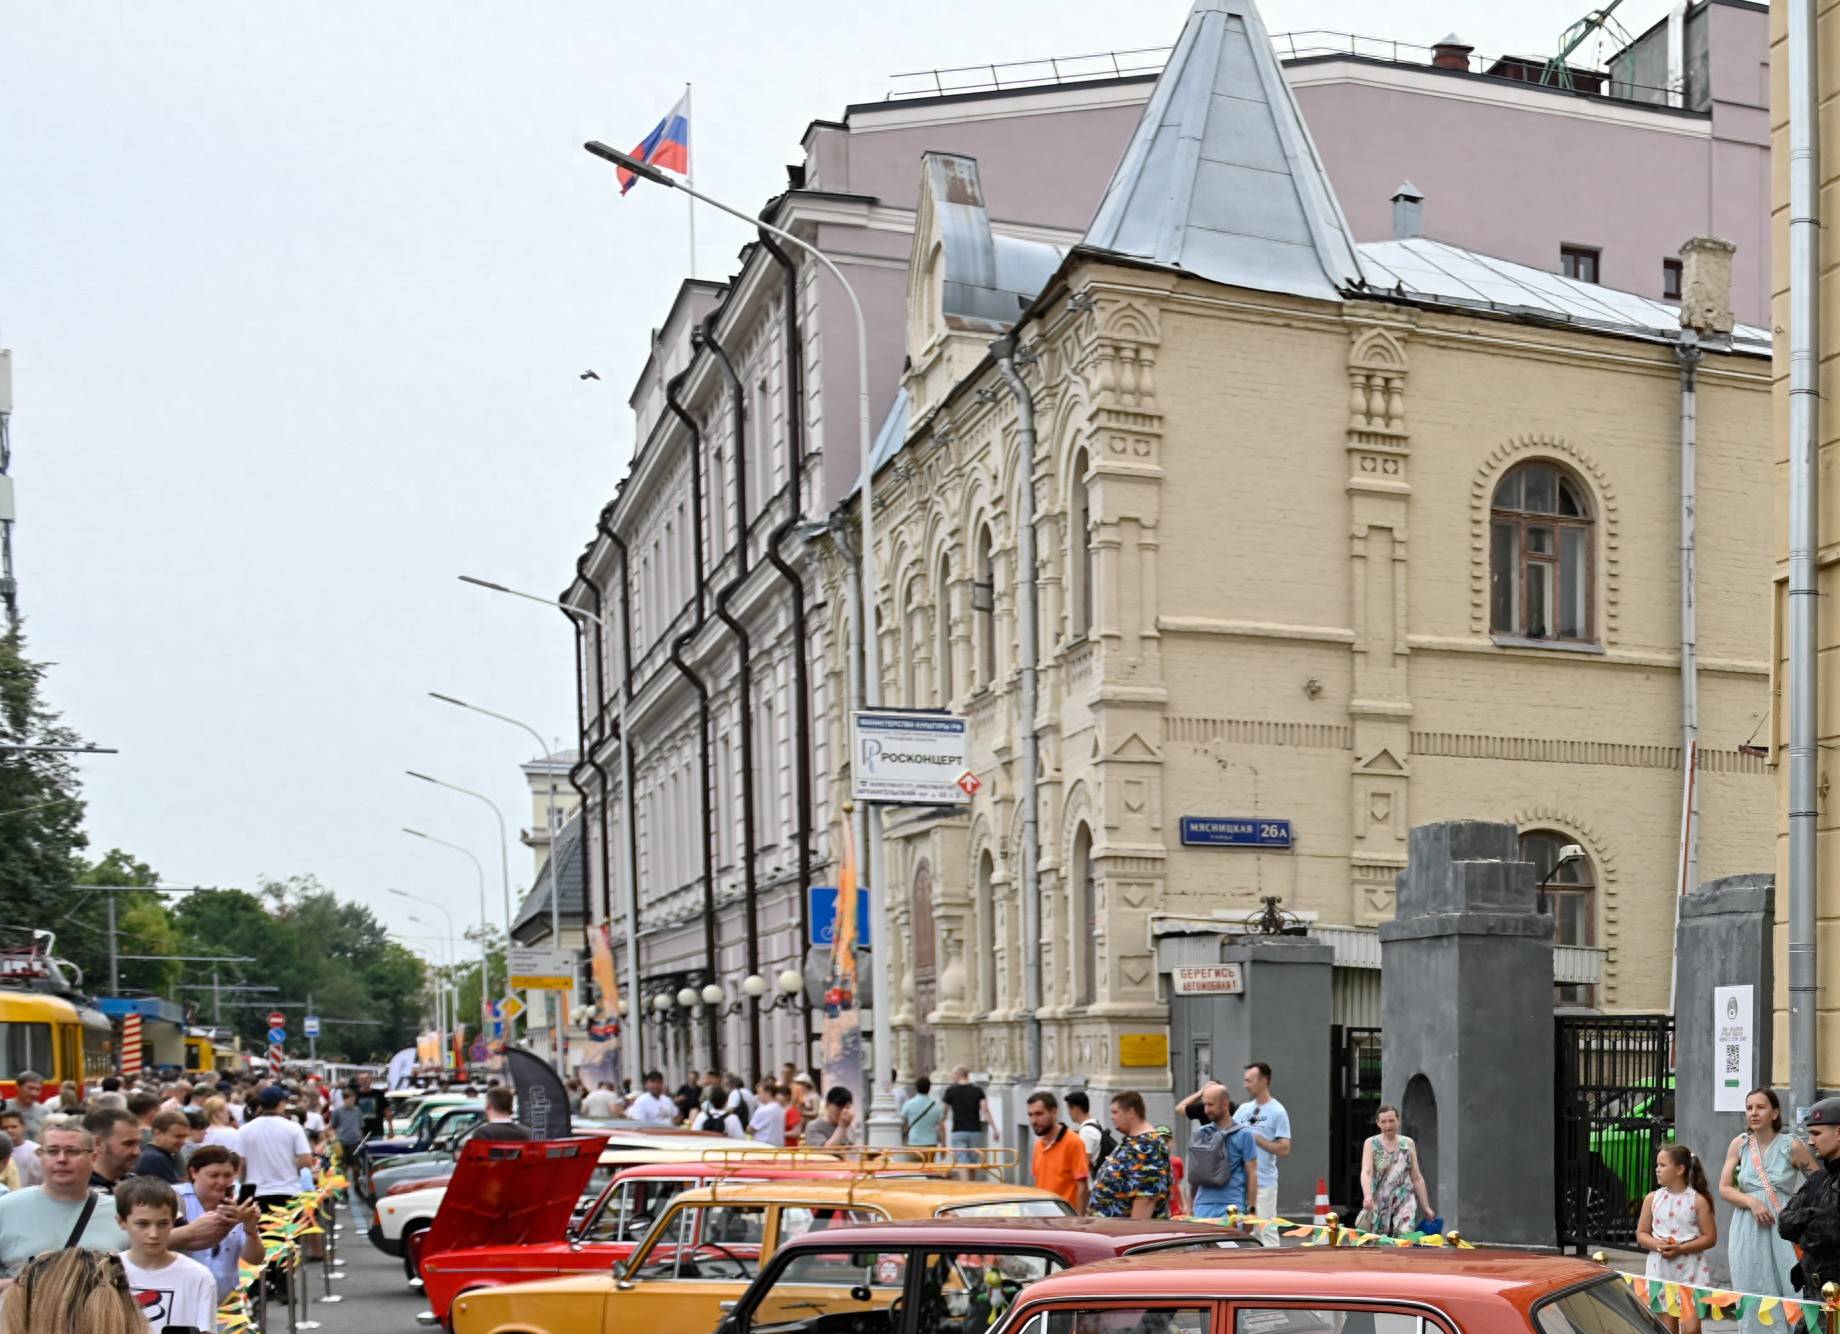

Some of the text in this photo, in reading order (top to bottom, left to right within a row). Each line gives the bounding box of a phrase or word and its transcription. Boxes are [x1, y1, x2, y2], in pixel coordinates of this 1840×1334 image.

[881, 752, 963, 766] РОСКОНЦЕРТ
[1190, 823, 1288, 839] МЯСНИЦКАЯ 26А
[1180, 967, 1236, 979] БЕРЕГИСЬ
